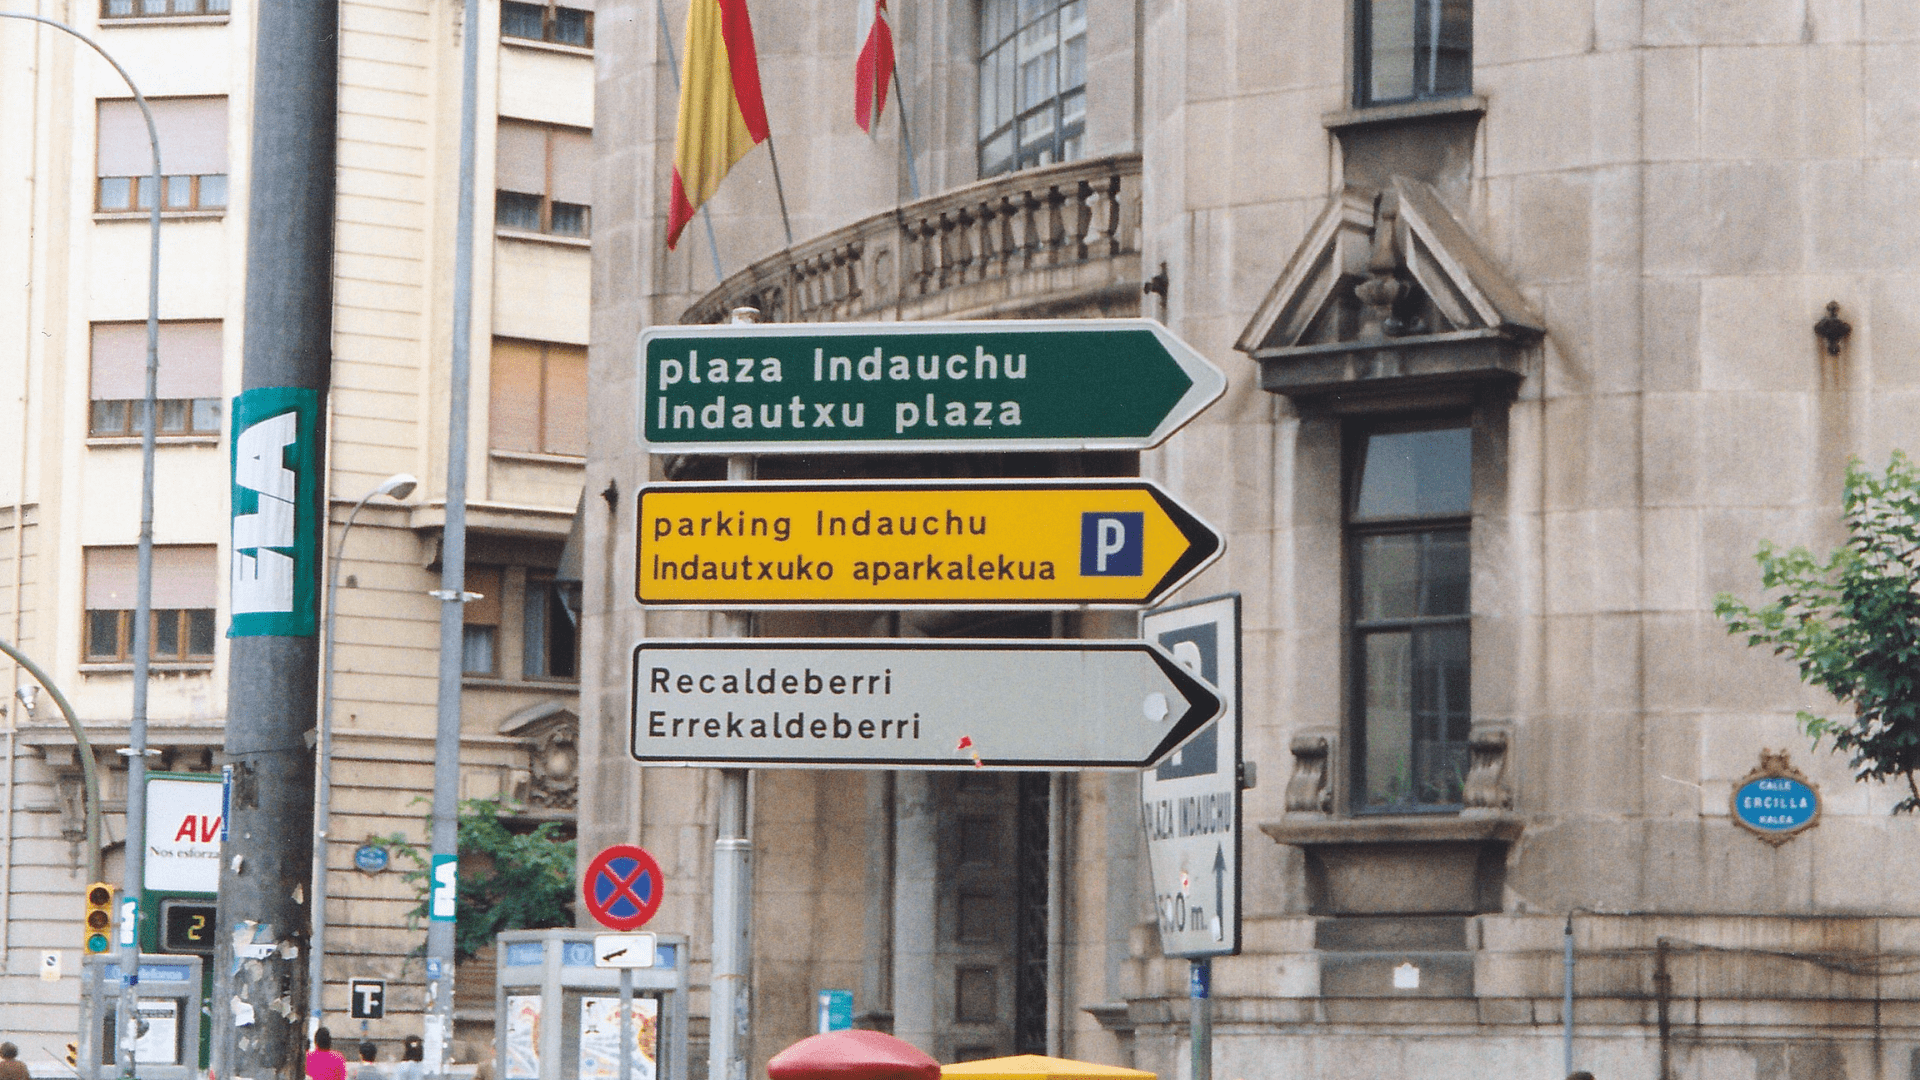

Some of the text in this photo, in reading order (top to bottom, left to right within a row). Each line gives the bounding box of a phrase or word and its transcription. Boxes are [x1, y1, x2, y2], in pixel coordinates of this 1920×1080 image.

[659, 346, 1027, 391] plaza Indauchu
[658, 393, 1022, 434] Indautxu plaza
[231, 411, 297, 614] ELA
[654, 509, 986, 542] parking Indauchu
[1097, 518, 1126, 572] P
[653, 553, 1056, 586] Indautxuko aparkalekua
[651, 667, 892, 695] Recaldeberri
[649, 711, 920, 739] Errekaldeberri
[1743, 796, 1808, 809] ERCILLA
[187, 914, 206, 941] 2
